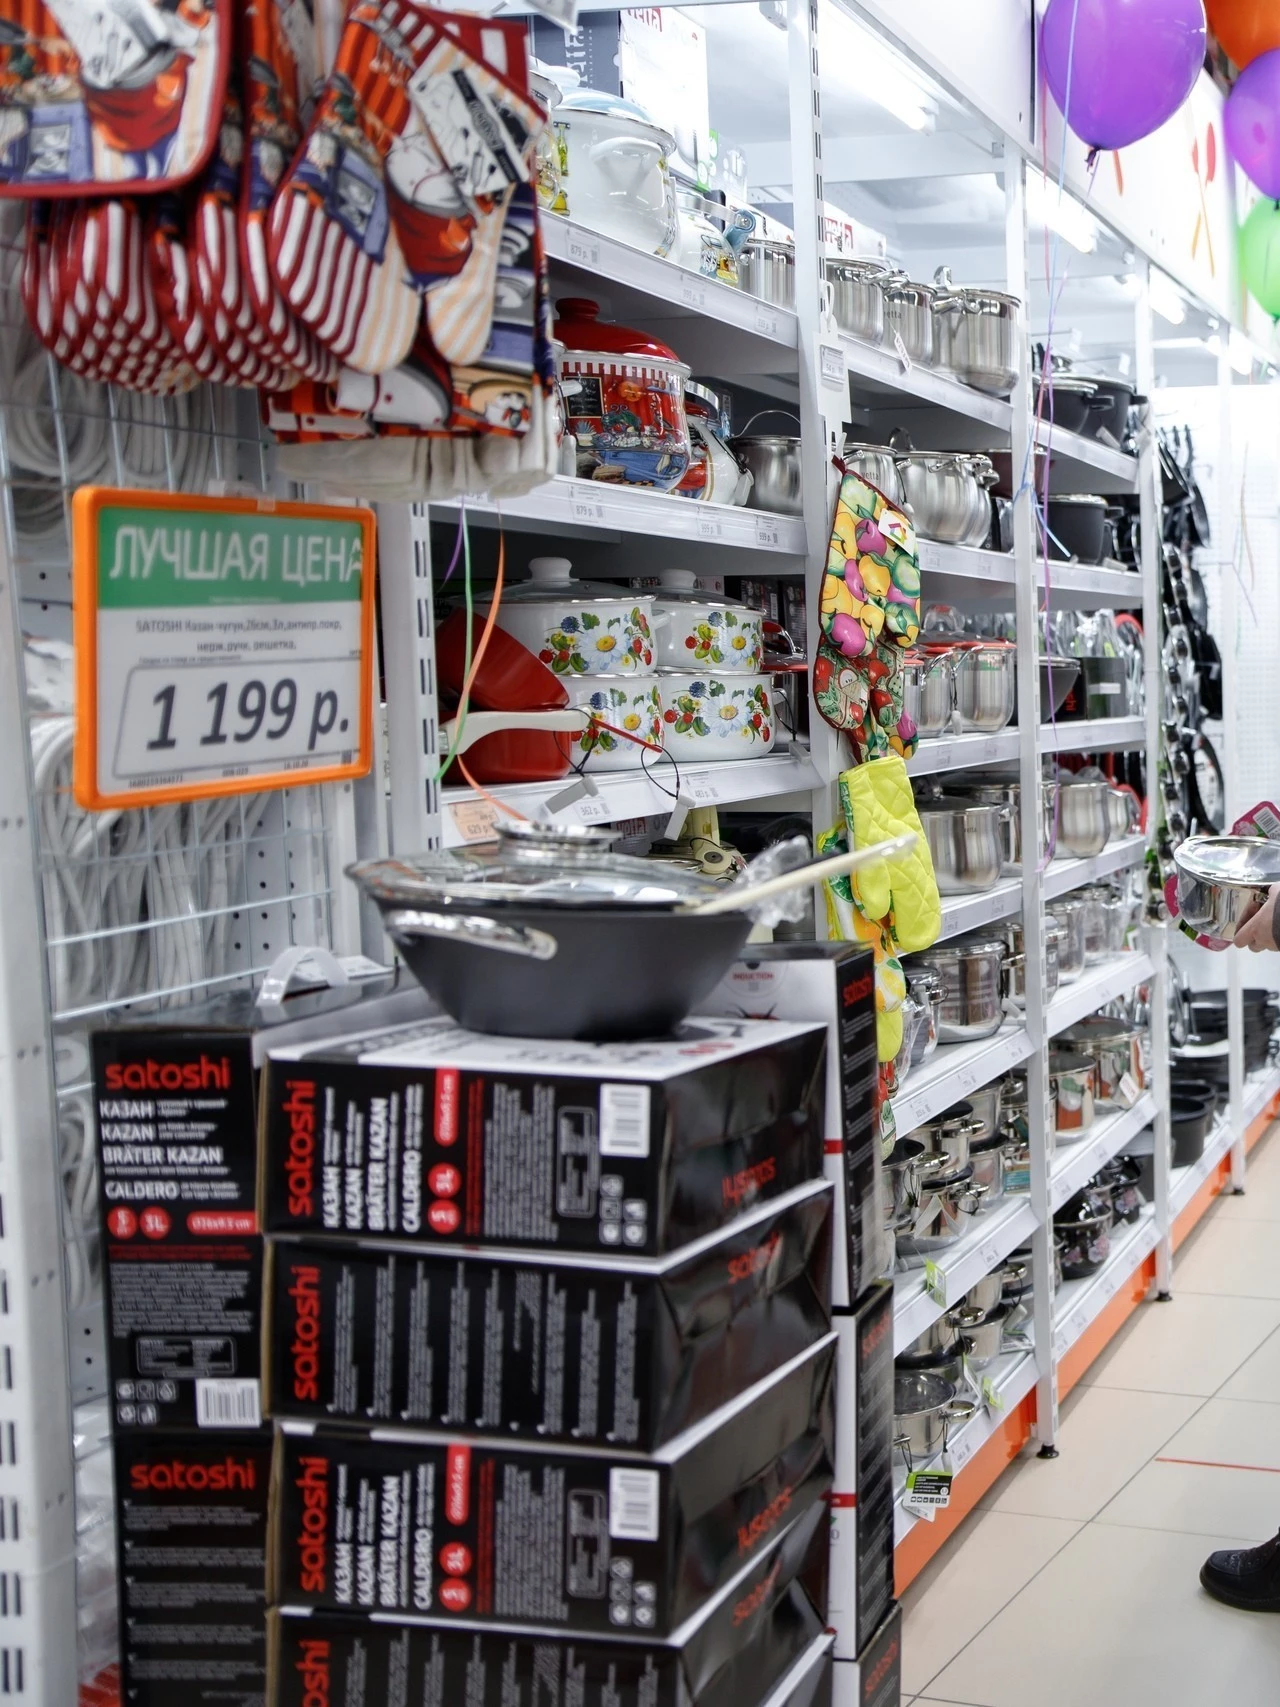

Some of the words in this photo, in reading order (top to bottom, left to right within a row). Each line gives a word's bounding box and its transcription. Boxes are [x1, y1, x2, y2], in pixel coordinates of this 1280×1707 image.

[109, 525, 271, 580] ЛУЧШАЯ
[281, 533, 364, 586] ЦЕНА
[146, 684, 177, 751] 1
[200, 677, 298, 746] 199
[308, 689, 349, 751] р.
[104, 1054, 231, 1090] satoshi
[100, 1099, 156, 1119] КАЗАН
[101, 1122, 156, 1142] KAZAN
[369, 1097, 388, 1160] KAZAN
[103, 1143, 165, 1165] BRÄTER
[167, 1146, 223, 1165] KAZAN
[282, 1080, 317, 1217] satoshi
[105, 1180, 180, 1200] CALDERO
[323, 1166, 341, 1229] КАЗАН
[345, 1167, 363, 1230] KAZAN
[366, 1161, 387, 1231] BRÄTER
[402, 1150, 422, 1233] CALDERO
[288, 1265, 321, 1401] satoshi
[130, 1456, 256, 1490] satoshi
[295, 1456, 329, 1593] satoshi
[381, 1475, 400, 1537] KAZAN
[335, 1543, 353, 1604] КАЗАН
[357, 1545, 375, 1606] KAZAN
[413, 1527, 433, 1610] CALDERO
[295, 1640, 331, 1707] oshi
